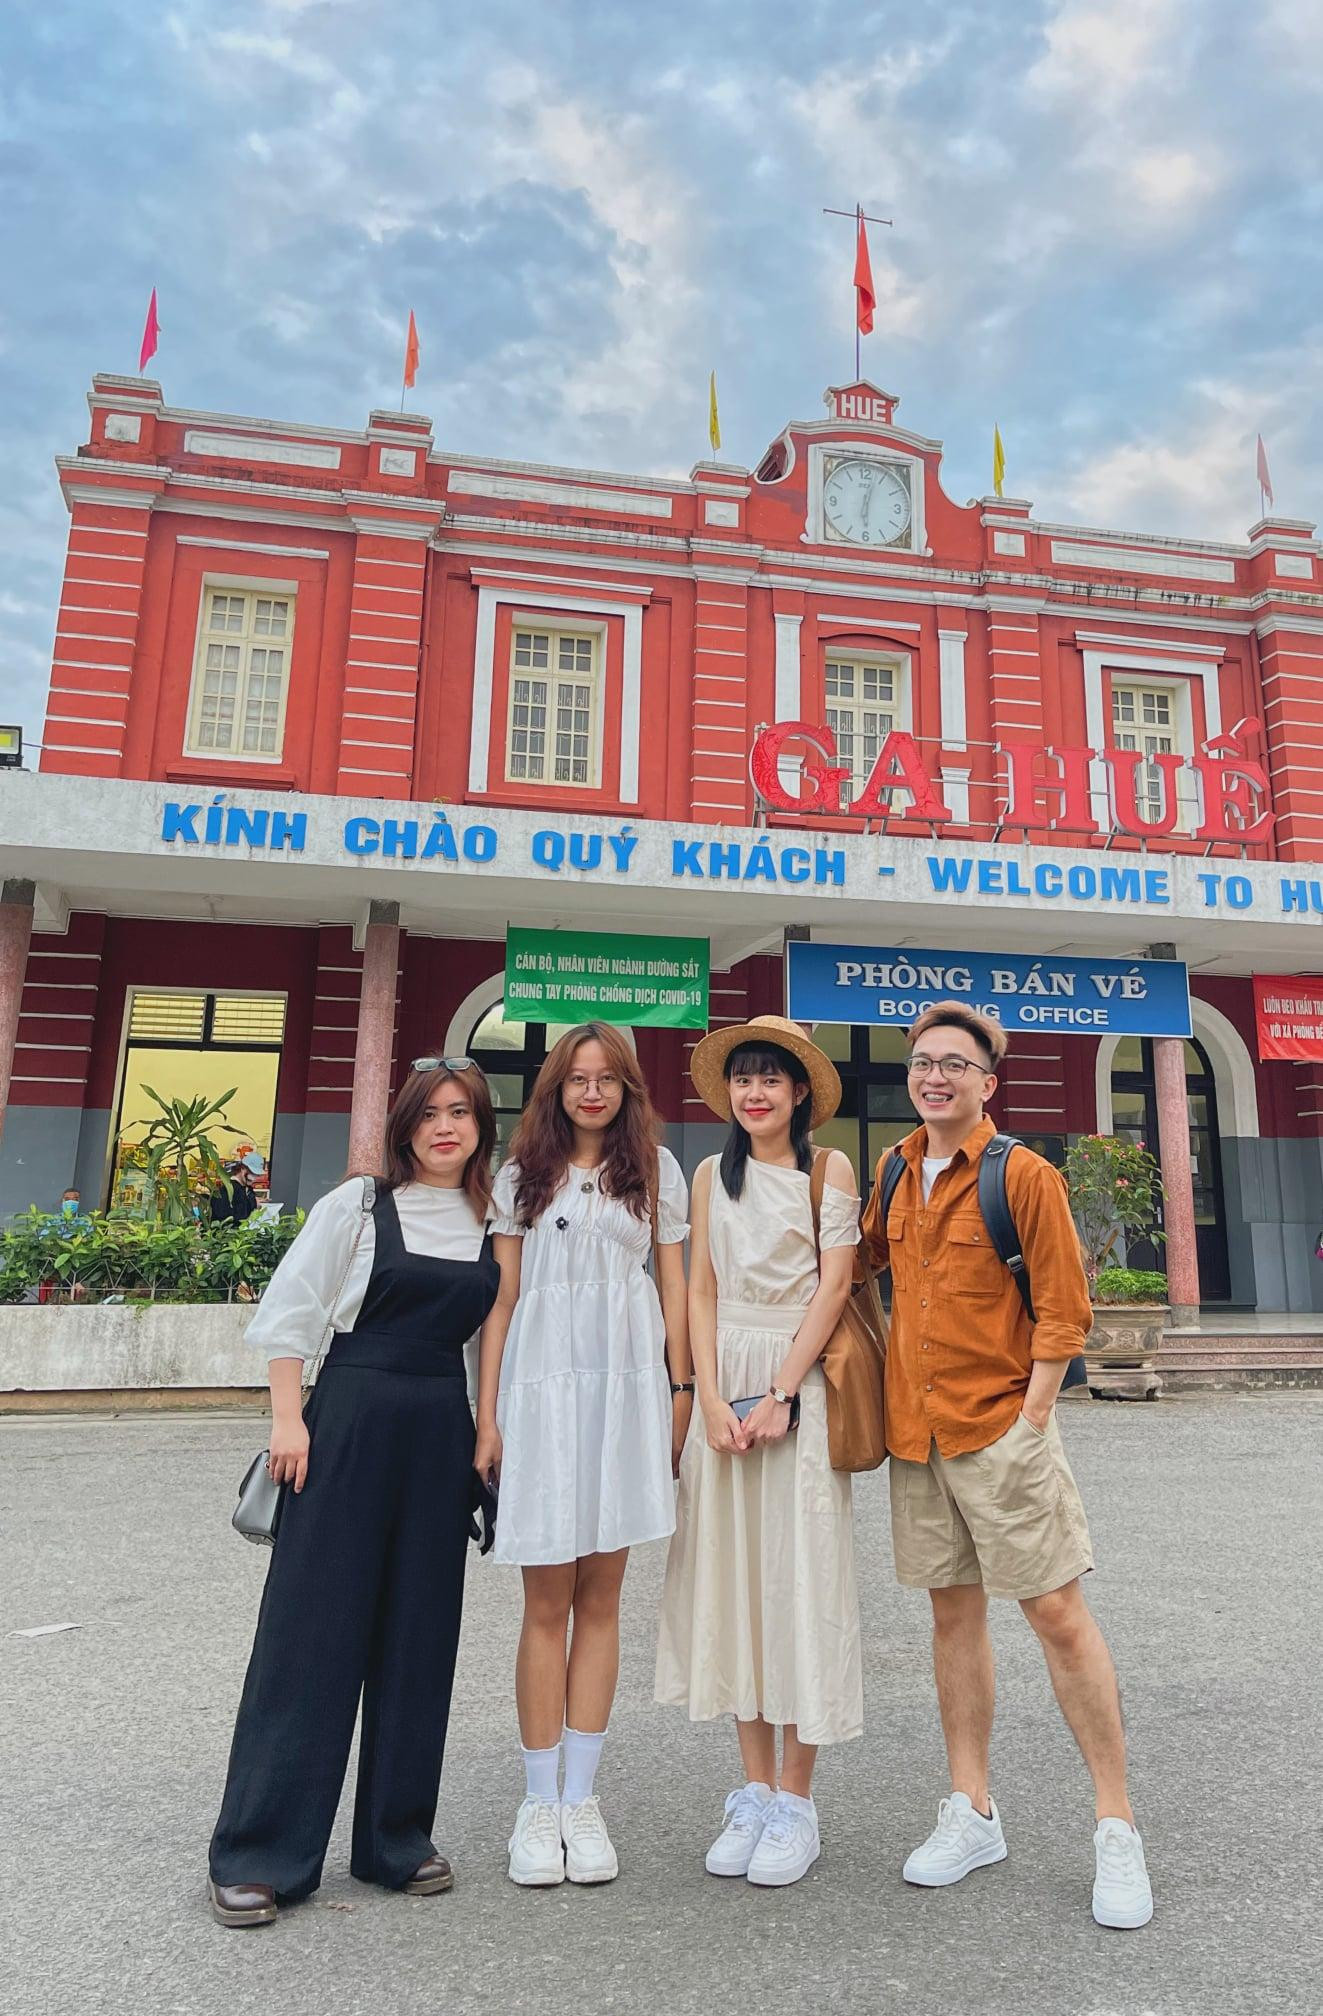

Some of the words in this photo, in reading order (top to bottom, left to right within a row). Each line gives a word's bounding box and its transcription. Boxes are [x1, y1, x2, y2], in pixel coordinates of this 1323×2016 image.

[841, 393, 886, 422] HUE
[859, 468, 871, 480] 12
[829, 495, 837, 507] 9
[893, 503, 902, 514] 3
[861, 530, 870, 542] 6
[748, 720, 952, 822] GA
[997, 716, 1276, 845] HUẾ
[161, 794, 308, 850] KÍNH
[344, 811, 498, 863] CHÀO
[531, 826, 638, 872] QUÝ
[672, 835, 846, 886] KHÁCH
[879, 867, 896, 876] -
[927, 856, 1169, 905] WELCOME
[1196, 873, 1253, 909] TO
[515, 952, 535, 970] CÁN
[538, 953, 555, 974] BỘ,
[557, 954, 585, 973] NHÂN
[587, 956, 609, 974] VIÊN
[611, 958, 645, 976] NGÀNH
[647, 957, 679, 977] ĐƯỜNG
[681, 957, 700, 978] SẮT
[835, 956, 974, 993] PHÒNG
[989, 962, 1077, 997] BÁN
[1089, 966, 1148, 1000] VÉ
[508, 982, 542, 999] CHUNG
[545, 983, 562, 1000] TAY
[563, 983, 597, 1001] PHÒNG
[599, 982, 632, 1003] CHỐNG
[634, 988, 657, 1007] DỊCH
[659, 988, 701, 1006] COVID-19
[1018, 1005, 1109, 1026] OFFICE
